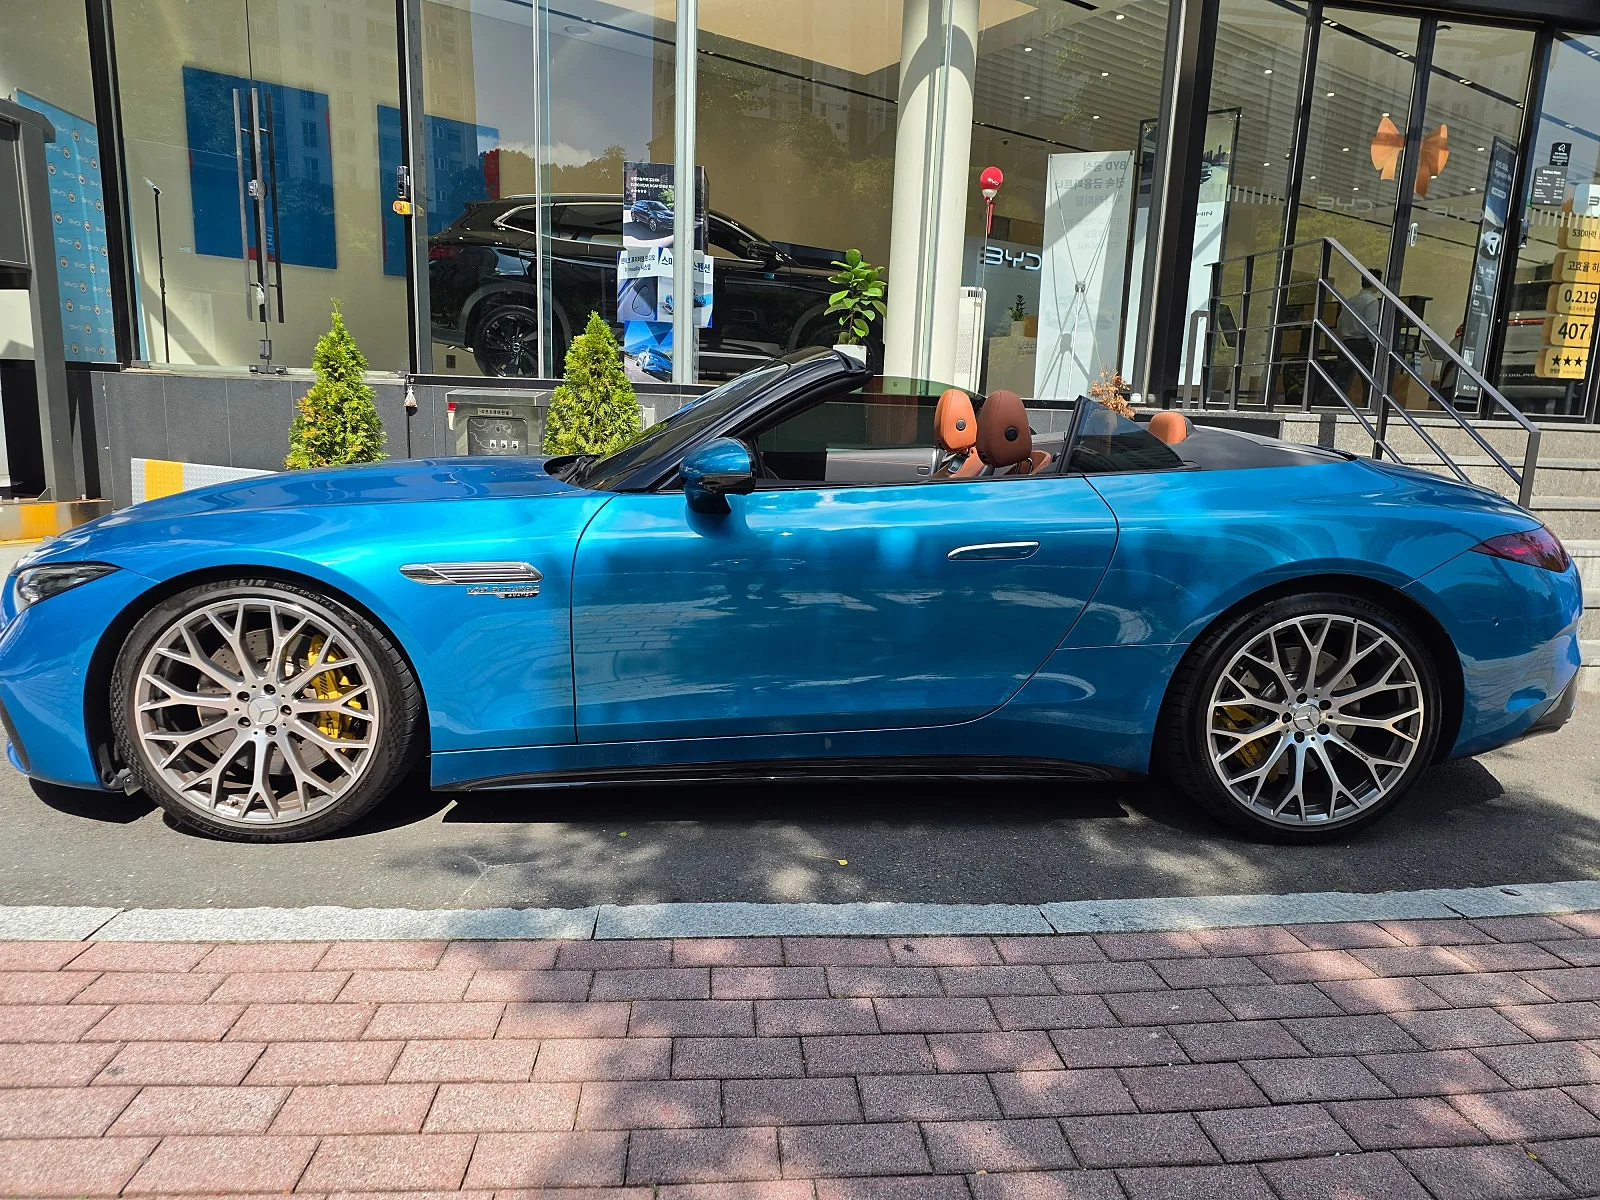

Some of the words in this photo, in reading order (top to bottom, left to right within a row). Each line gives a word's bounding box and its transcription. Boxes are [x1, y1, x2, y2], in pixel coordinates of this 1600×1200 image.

[987, 177, 999, 186] BYD
[1316, 195, 1373, 213] BYD
[984, 245, 1042, 270] BYD
[1566, 260, 1590, 272] 고효율
[1592, 262, 1600, 273] 히
[1564, 289, 1598, 304] 0.219
[1558, 322, 1589, 340] 407
[273, 582, 297, 592] PILOT
[298, 589, 326, 604] SPORT
[490, 585, 540, 594] BITURBO
